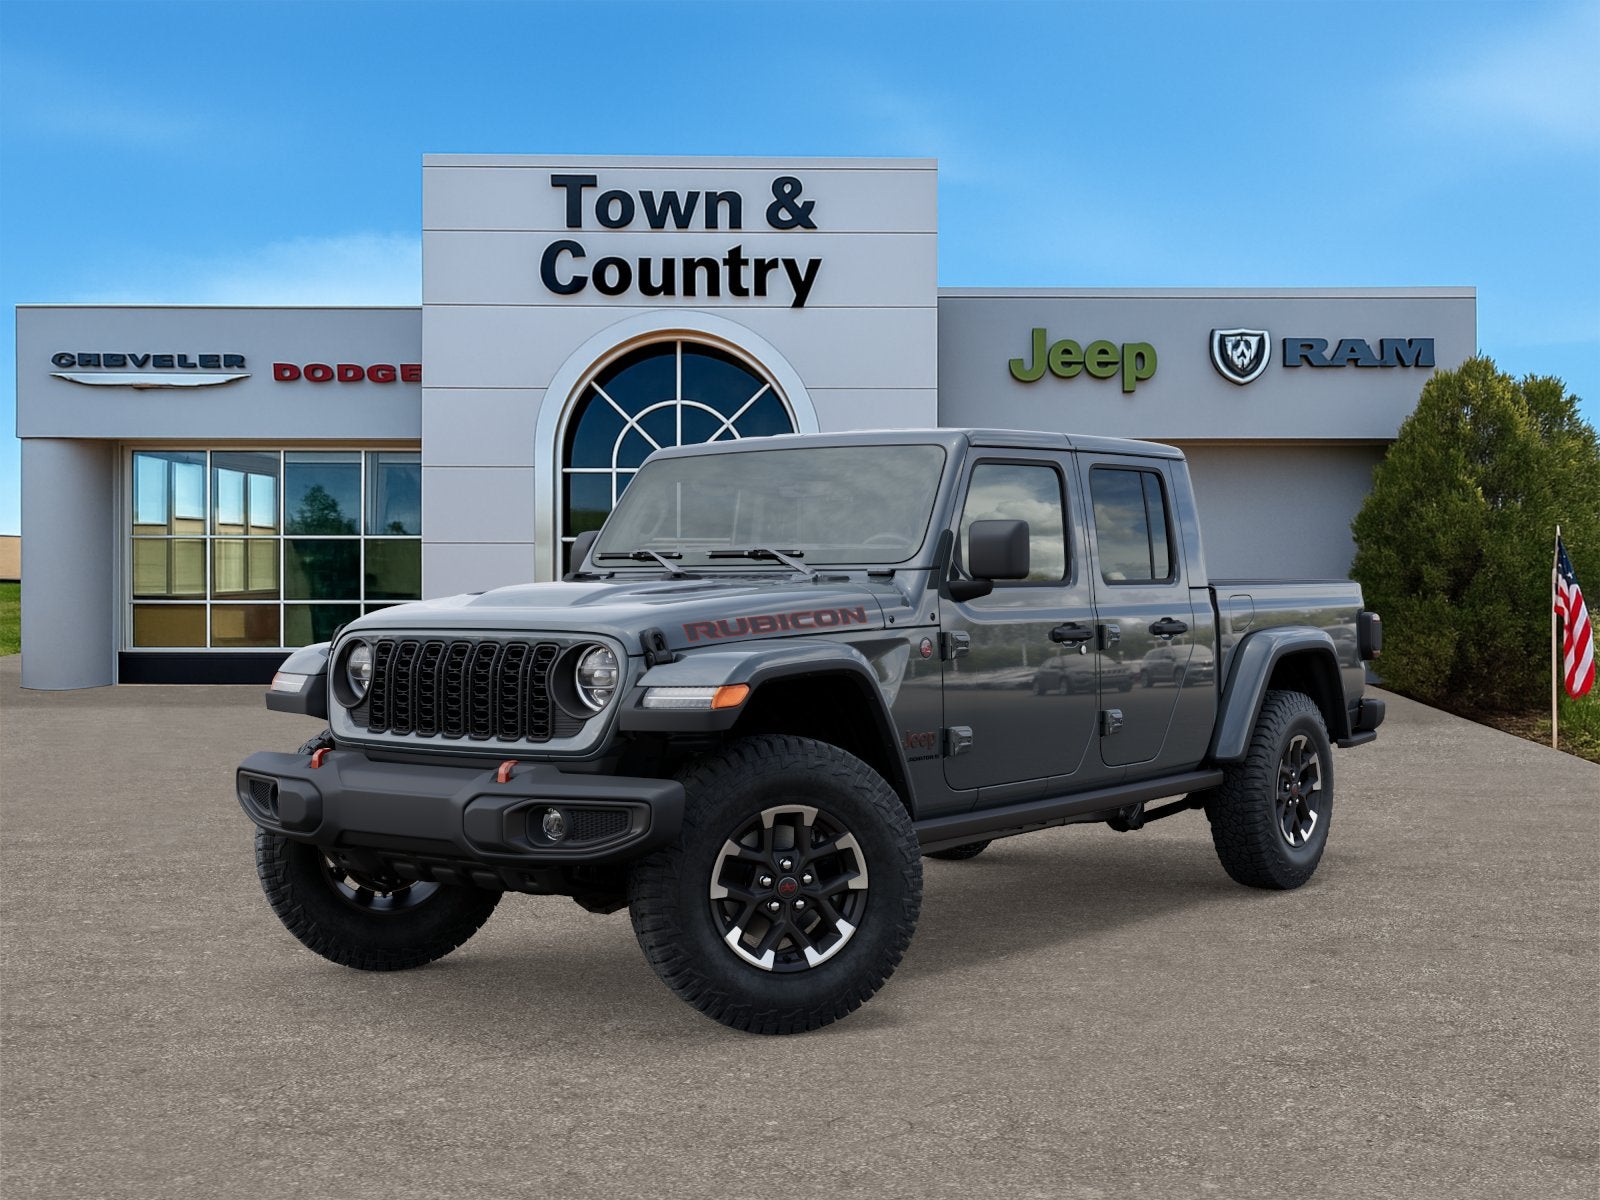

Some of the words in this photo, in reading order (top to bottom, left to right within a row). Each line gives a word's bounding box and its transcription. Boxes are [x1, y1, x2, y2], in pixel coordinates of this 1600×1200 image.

[550, 174, 743, 230] Town
[765, 176, 818, 231] &
[540, 239, 823, 309] Country
[273, 362, 421, 384] DODGE
[1008, 327, 1158, 394] Jeep
[1282, 337, 1436, 369] RAM
[683, 605, 868, 643] RUBICON
